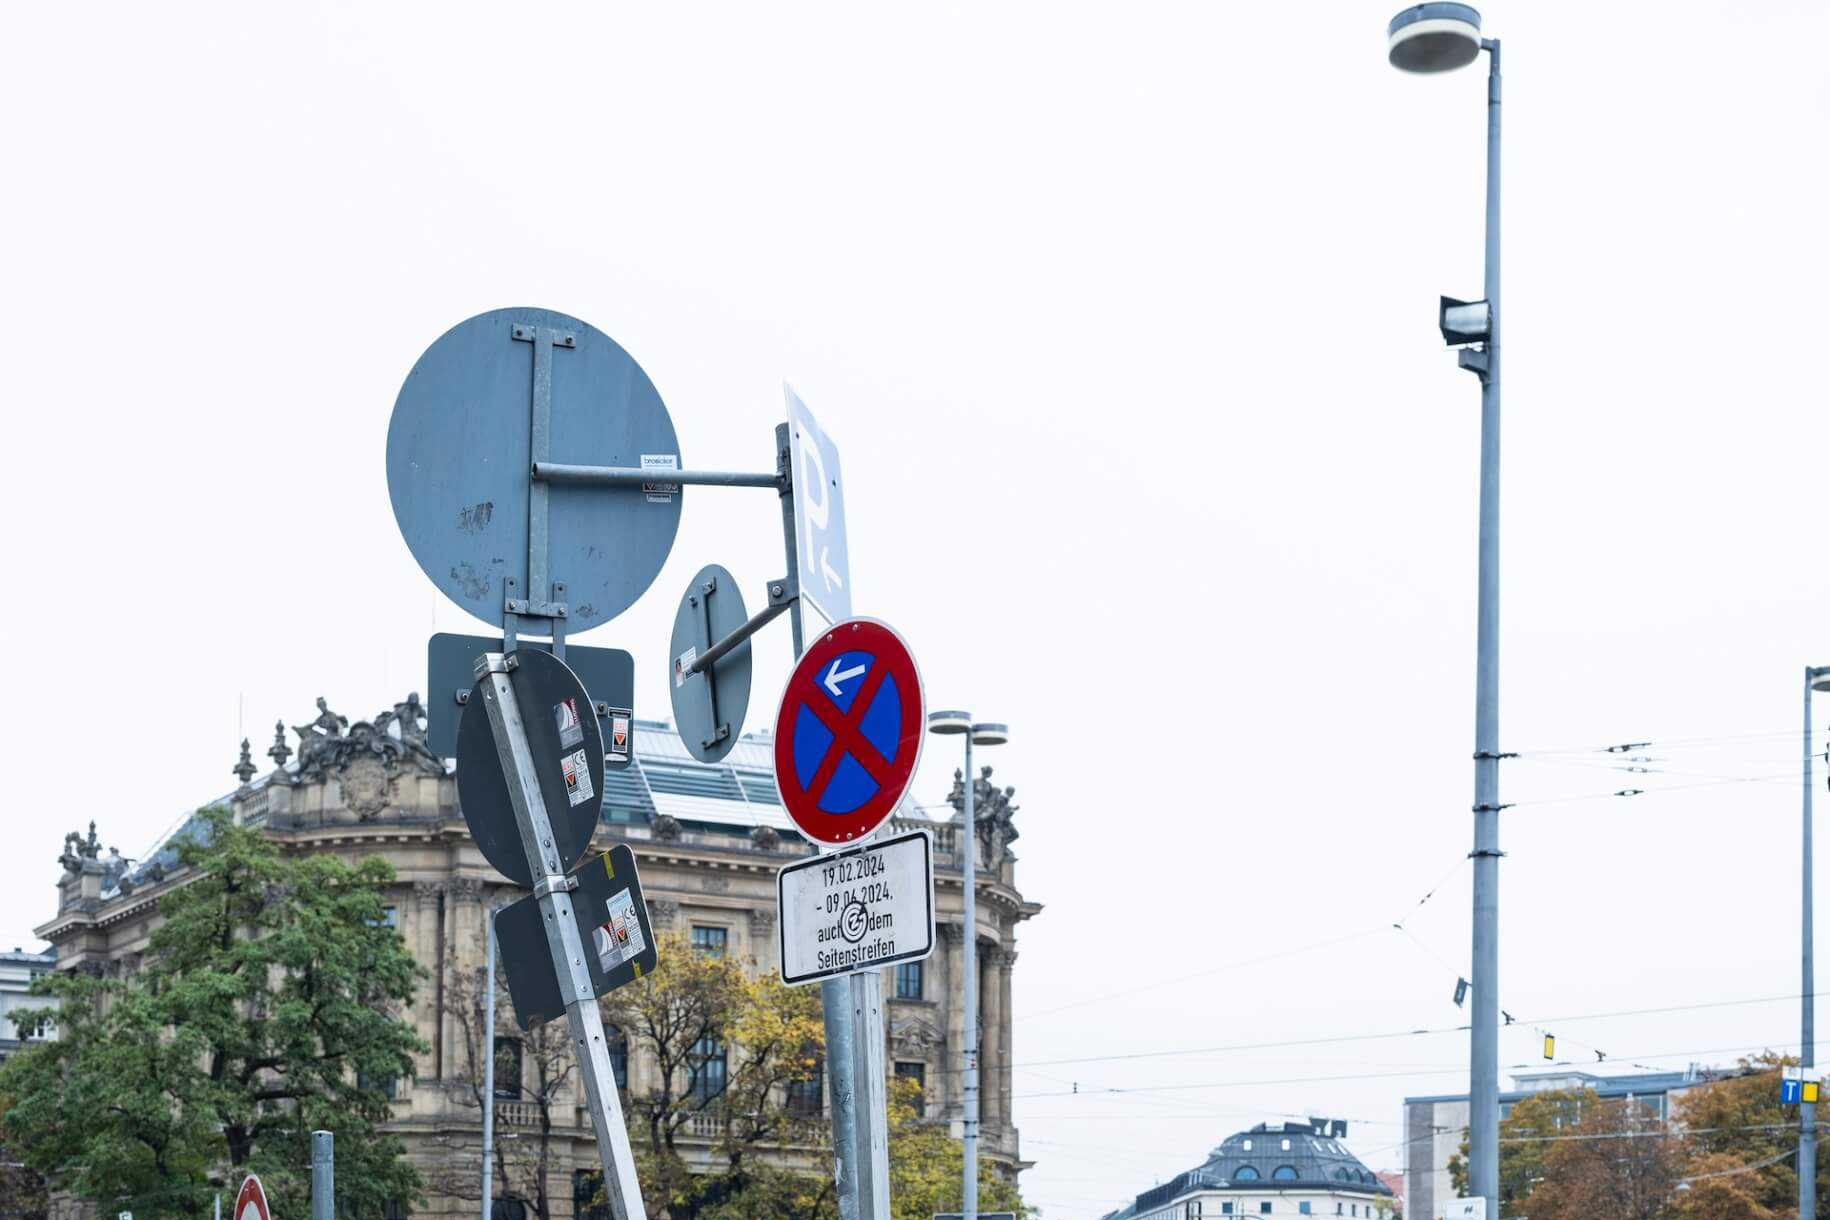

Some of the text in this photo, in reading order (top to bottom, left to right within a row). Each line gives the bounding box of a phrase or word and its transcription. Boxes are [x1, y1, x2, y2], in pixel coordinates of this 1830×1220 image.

[797, 420, 829, 576] P
[822, 855, 885, 888] 19.02.2024
[826, 882, 894, 914] 09.062024.
[869, 912, 893, 931] dem
[817, 940, 895, 969] Seitenstreifen
